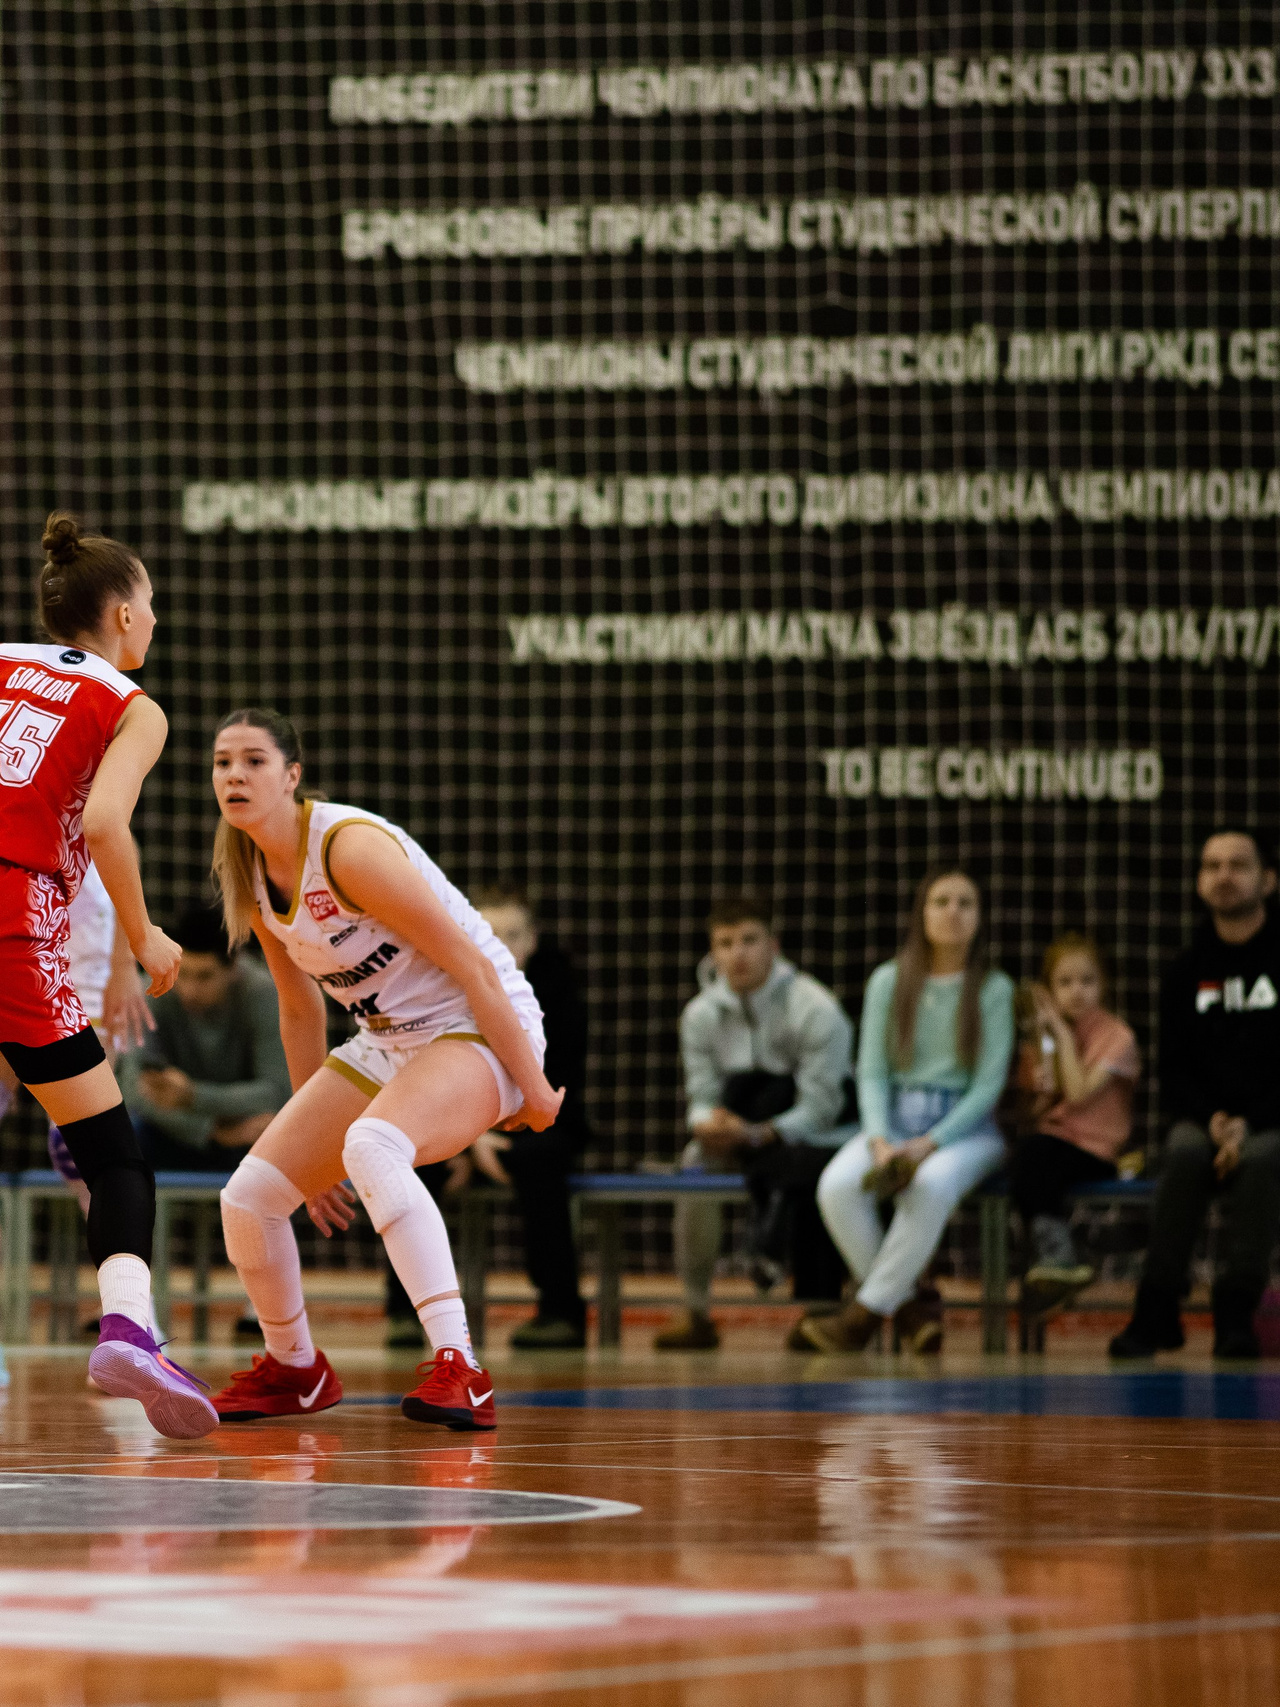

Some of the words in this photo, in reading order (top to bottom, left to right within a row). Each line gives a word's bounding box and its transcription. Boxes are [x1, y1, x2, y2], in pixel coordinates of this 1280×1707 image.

[329, 71, 593, 125] ПОБЕДИТЕЛИ
[597, 60, 865, 117] ЧЕМПИОНАТА
[869, 59, 928, 109] ПО
[932, 51, 1197, 109] БАСКЕТБОЛУ
[342, 207, 586, 261] БРОНЗОВЫЕ
[589, 191, 783, 254] ПРИЗЁРЫ
[787, 181, 1102, 256] СТУДЕНЧЕСКОЙ
[455, 341, 685, 393] ЧЕМПИОНЫ
[687, 323, 997, 394] СТУДЕНЧЕСКОЙ
[1120, 328, 1222, 390] РЖД
[183, 480, 420, 533] БРОНЗОВЫЕ
[425, 468, 620, 530] ПРИЗЁРЫ
[623, 473, 799, 526] ВТОРОГО
[803, 471, 1056, 533] ДИВИЗИОНА
[507, 611, 741, 665] УЧАСТНИКИ
[744, 608, 884, 662] МАТЧА
[886, 600, 1019, 668] ЗВЁЗД
[1025, 608, 1110, 662] АСБ
[5, 666, 81, 705] БОЙКОВА
[822, 748, 873, 799] TO
[877, 748, 934, 799] BE
[937, 748, 1163, 800] CONTINUED
[1195, 973, 1278, 1013] FILA
